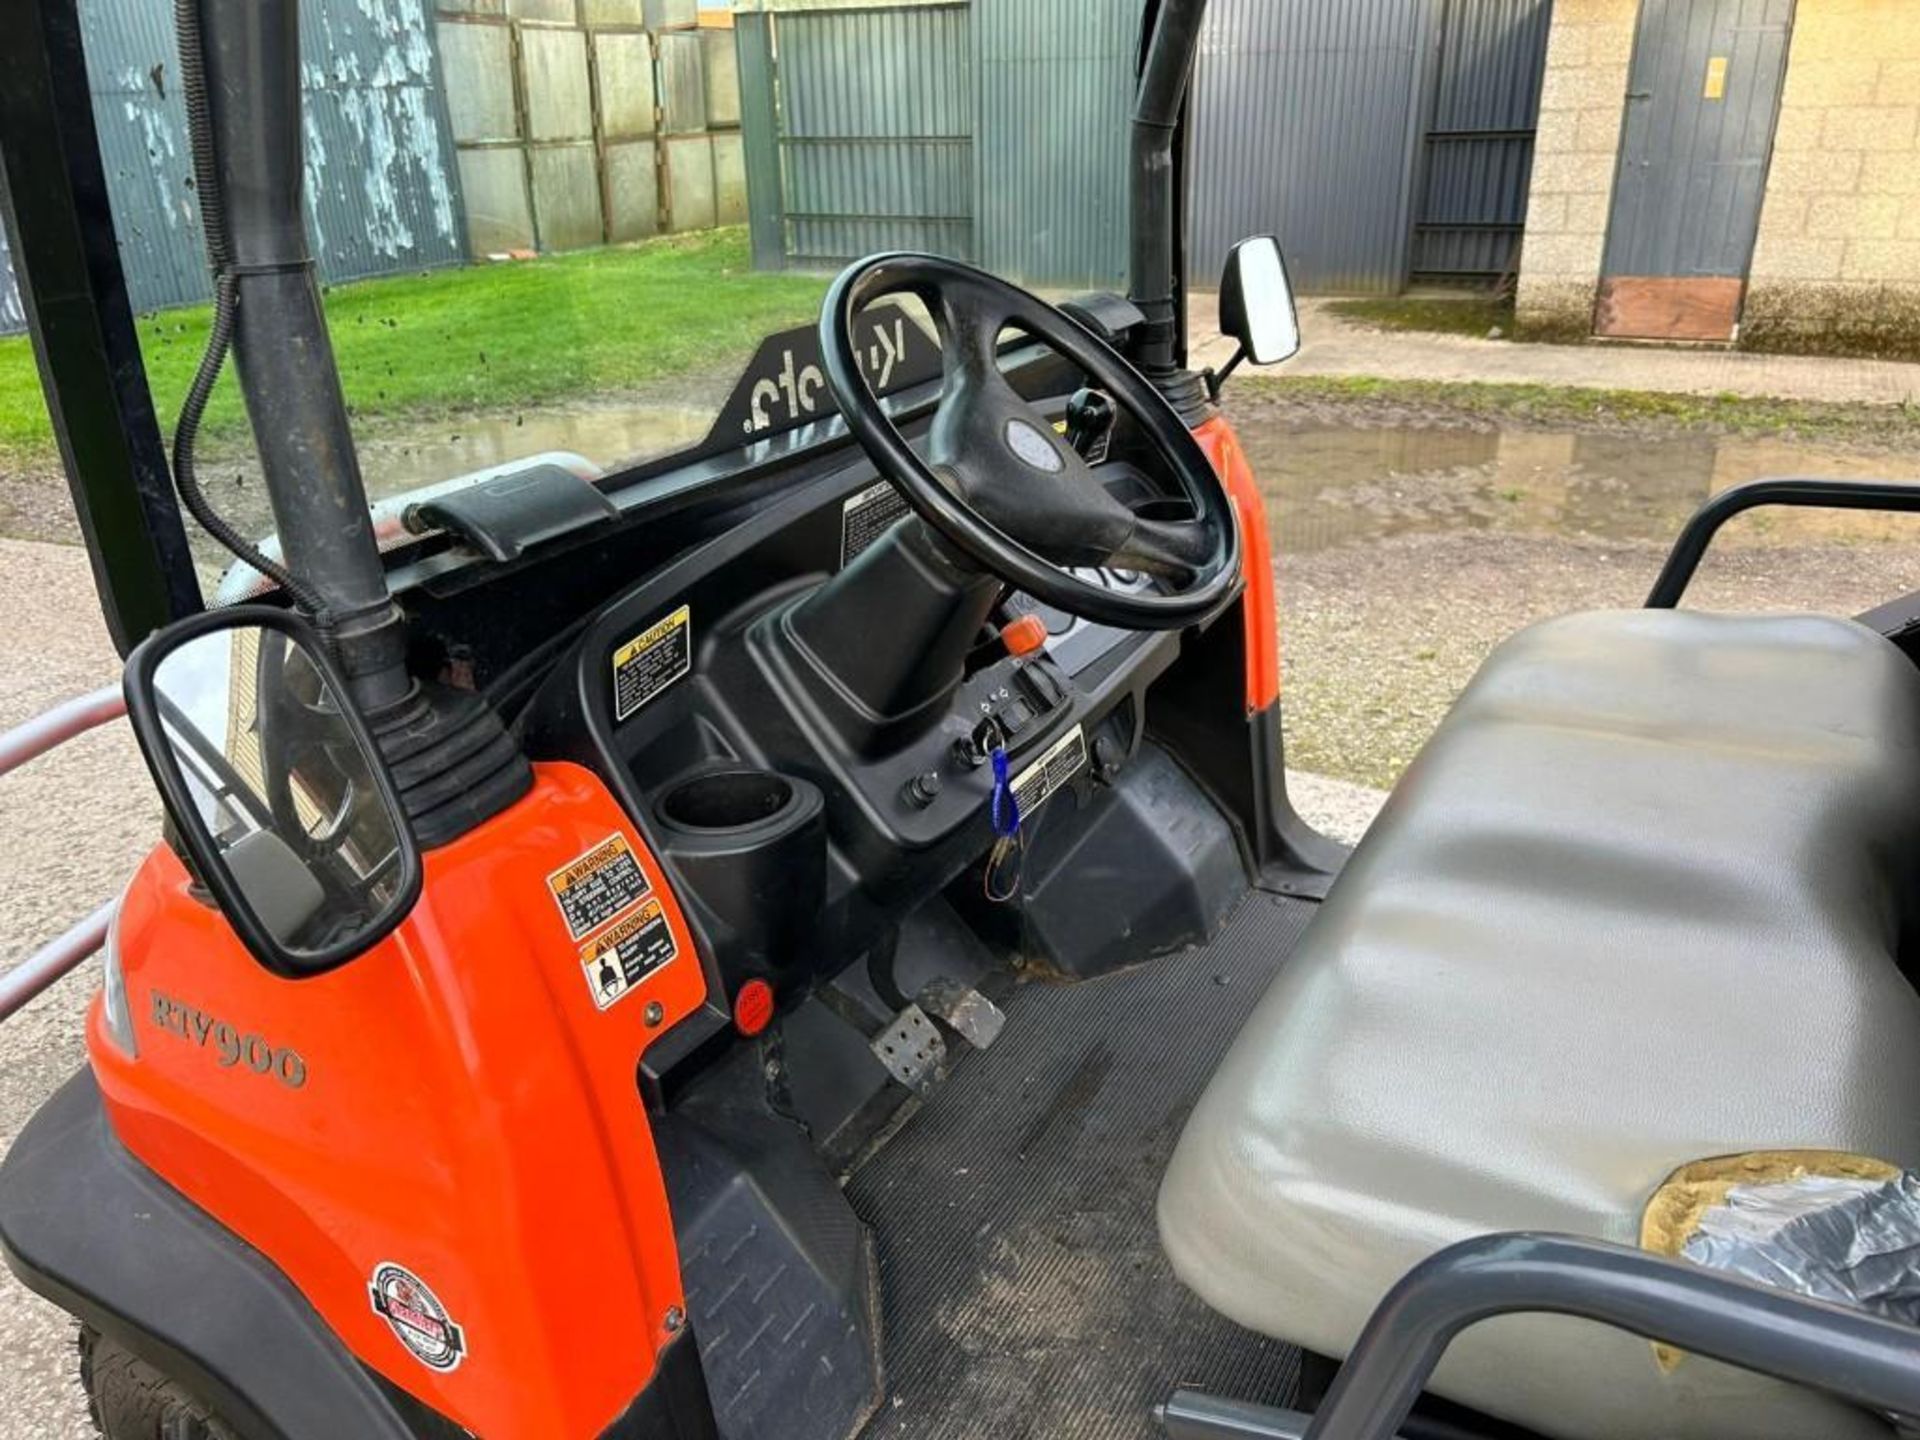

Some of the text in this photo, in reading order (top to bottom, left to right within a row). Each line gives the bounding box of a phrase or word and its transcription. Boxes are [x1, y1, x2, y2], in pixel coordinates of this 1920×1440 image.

[639, 618, 676, 647] CAUTION
[572, 843, 619, 877] WARNING
[601, 909, 651, 947] WARNING
[152, 988, 307, 1088] RTV900
